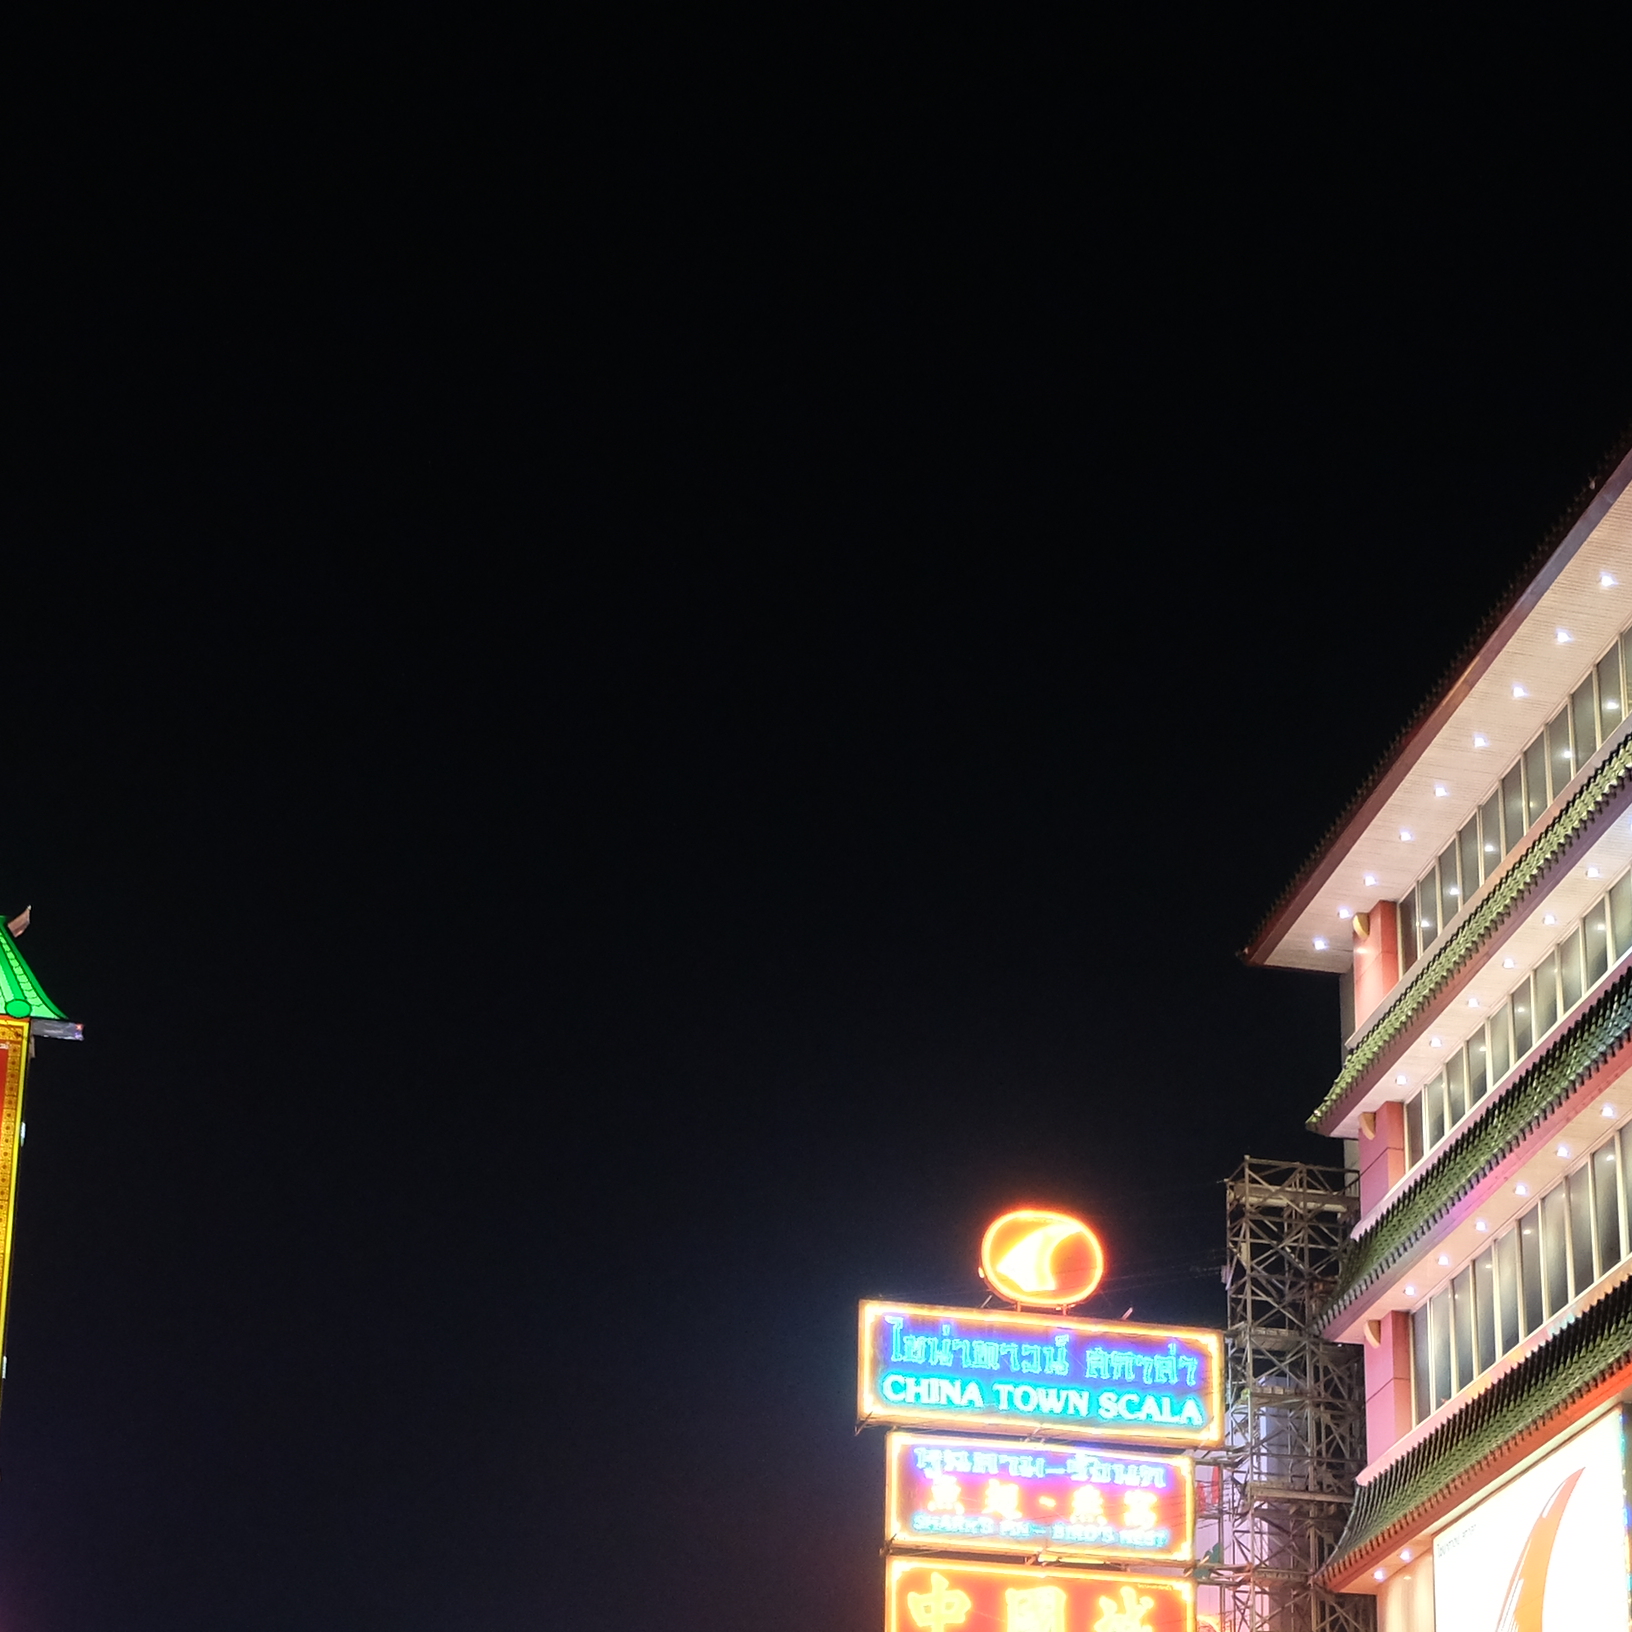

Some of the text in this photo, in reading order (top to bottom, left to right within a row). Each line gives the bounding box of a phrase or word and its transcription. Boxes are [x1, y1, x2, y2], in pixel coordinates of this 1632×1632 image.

[882, 1374, 1204, 1426] CHINA TOWN SCALA
